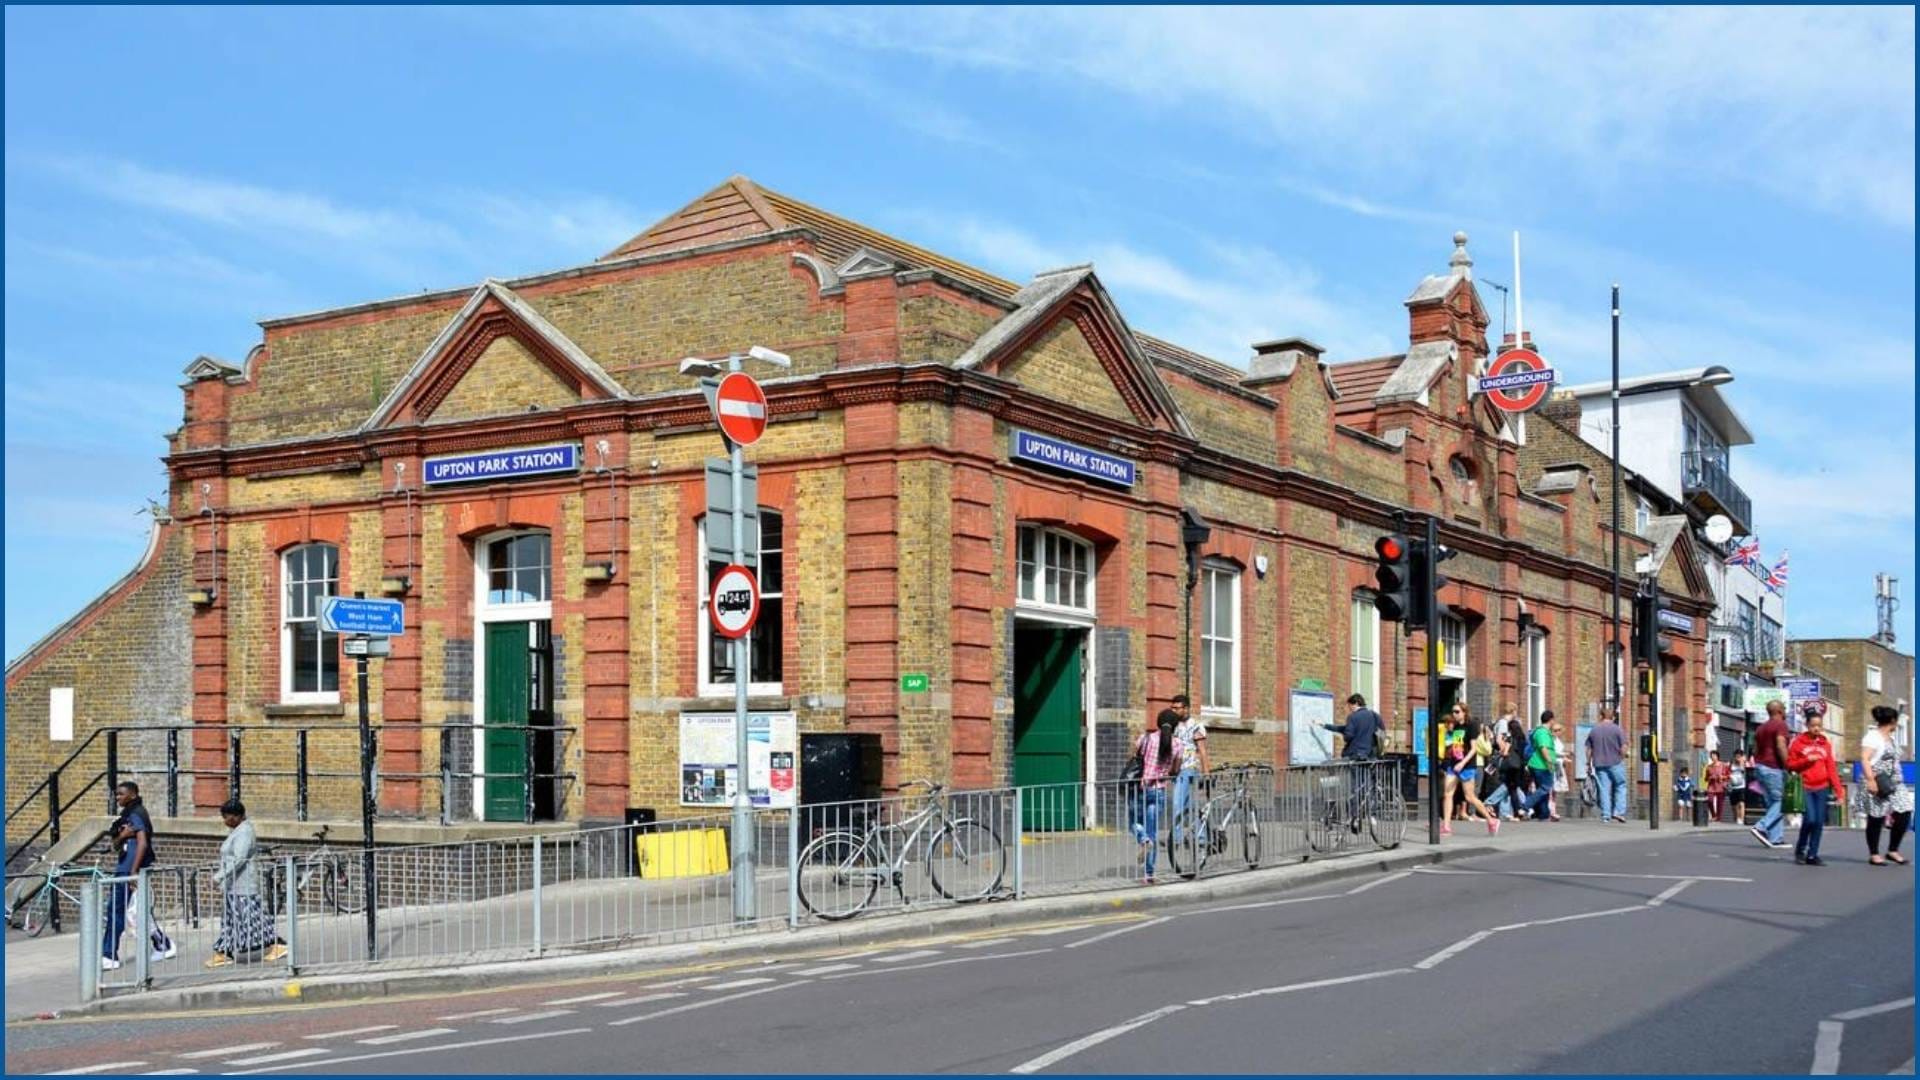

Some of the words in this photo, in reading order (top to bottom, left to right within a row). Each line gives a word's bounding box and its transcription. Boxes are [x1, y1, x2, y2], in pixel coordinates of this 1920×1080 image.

[1482, 371, 1552, 388] UNDERGROUND
[433, 461, 475, 478] UPTON
[478, 457, 509, 473] PARK
[512, 451, 564, 470] STATION
[1025, 439, 1060, 461] UPTON
[1063, 450, 1088, 469] PARK
[1090, 458, 1128, 479] STATION
[348, 612, 366, 621] West
[339, 621, 366, 630] football
[367, 623, 392, 632] ground
[907, 679, 922, 687] SAP
